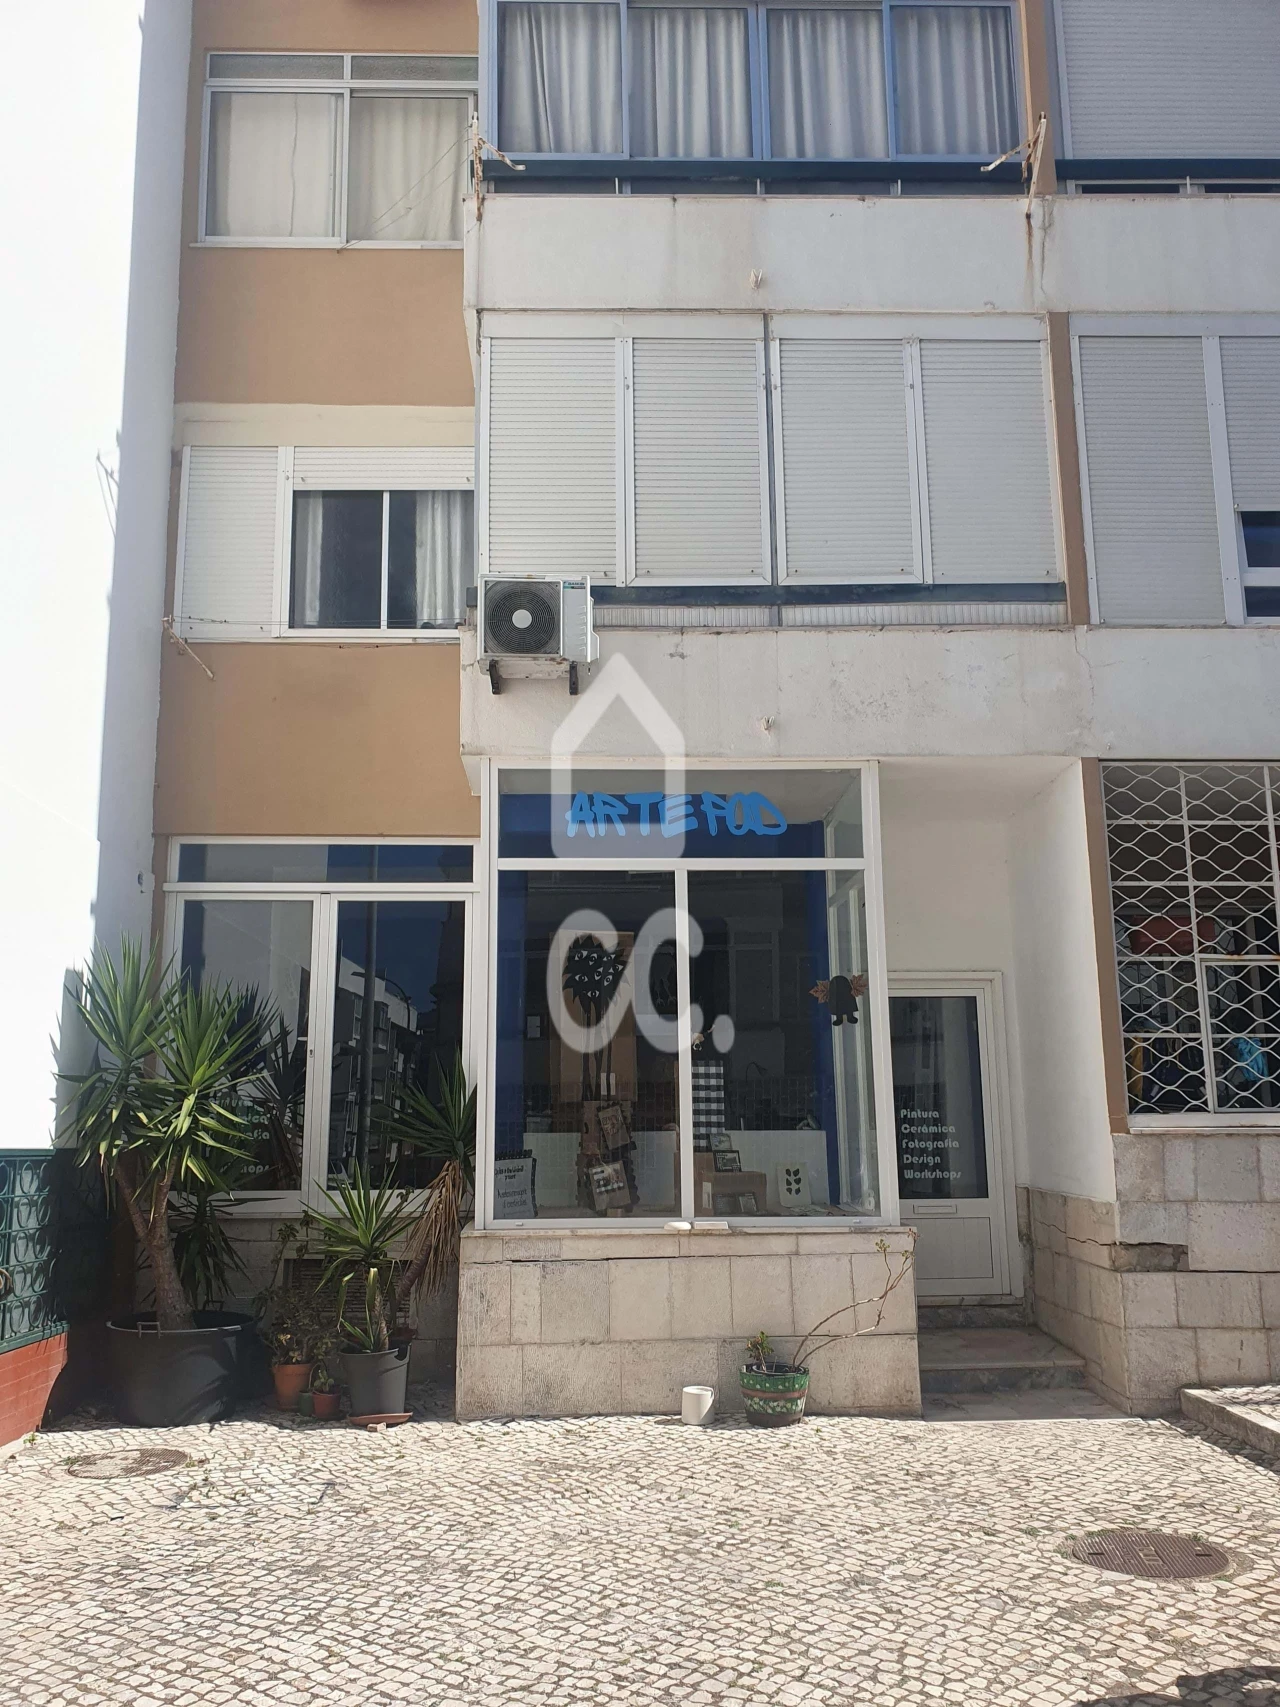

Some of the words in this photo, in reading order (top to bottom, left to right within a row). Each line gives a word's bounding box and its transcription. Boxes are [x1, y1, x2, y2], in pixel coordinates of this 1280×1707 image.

[900, 1108, 940, 1119] Pintura
[902, 1138, 960, 1151] Fotografia
[903, 1153, 941, 1166] Design
[904, 1169, 962, 1180] Workshops
